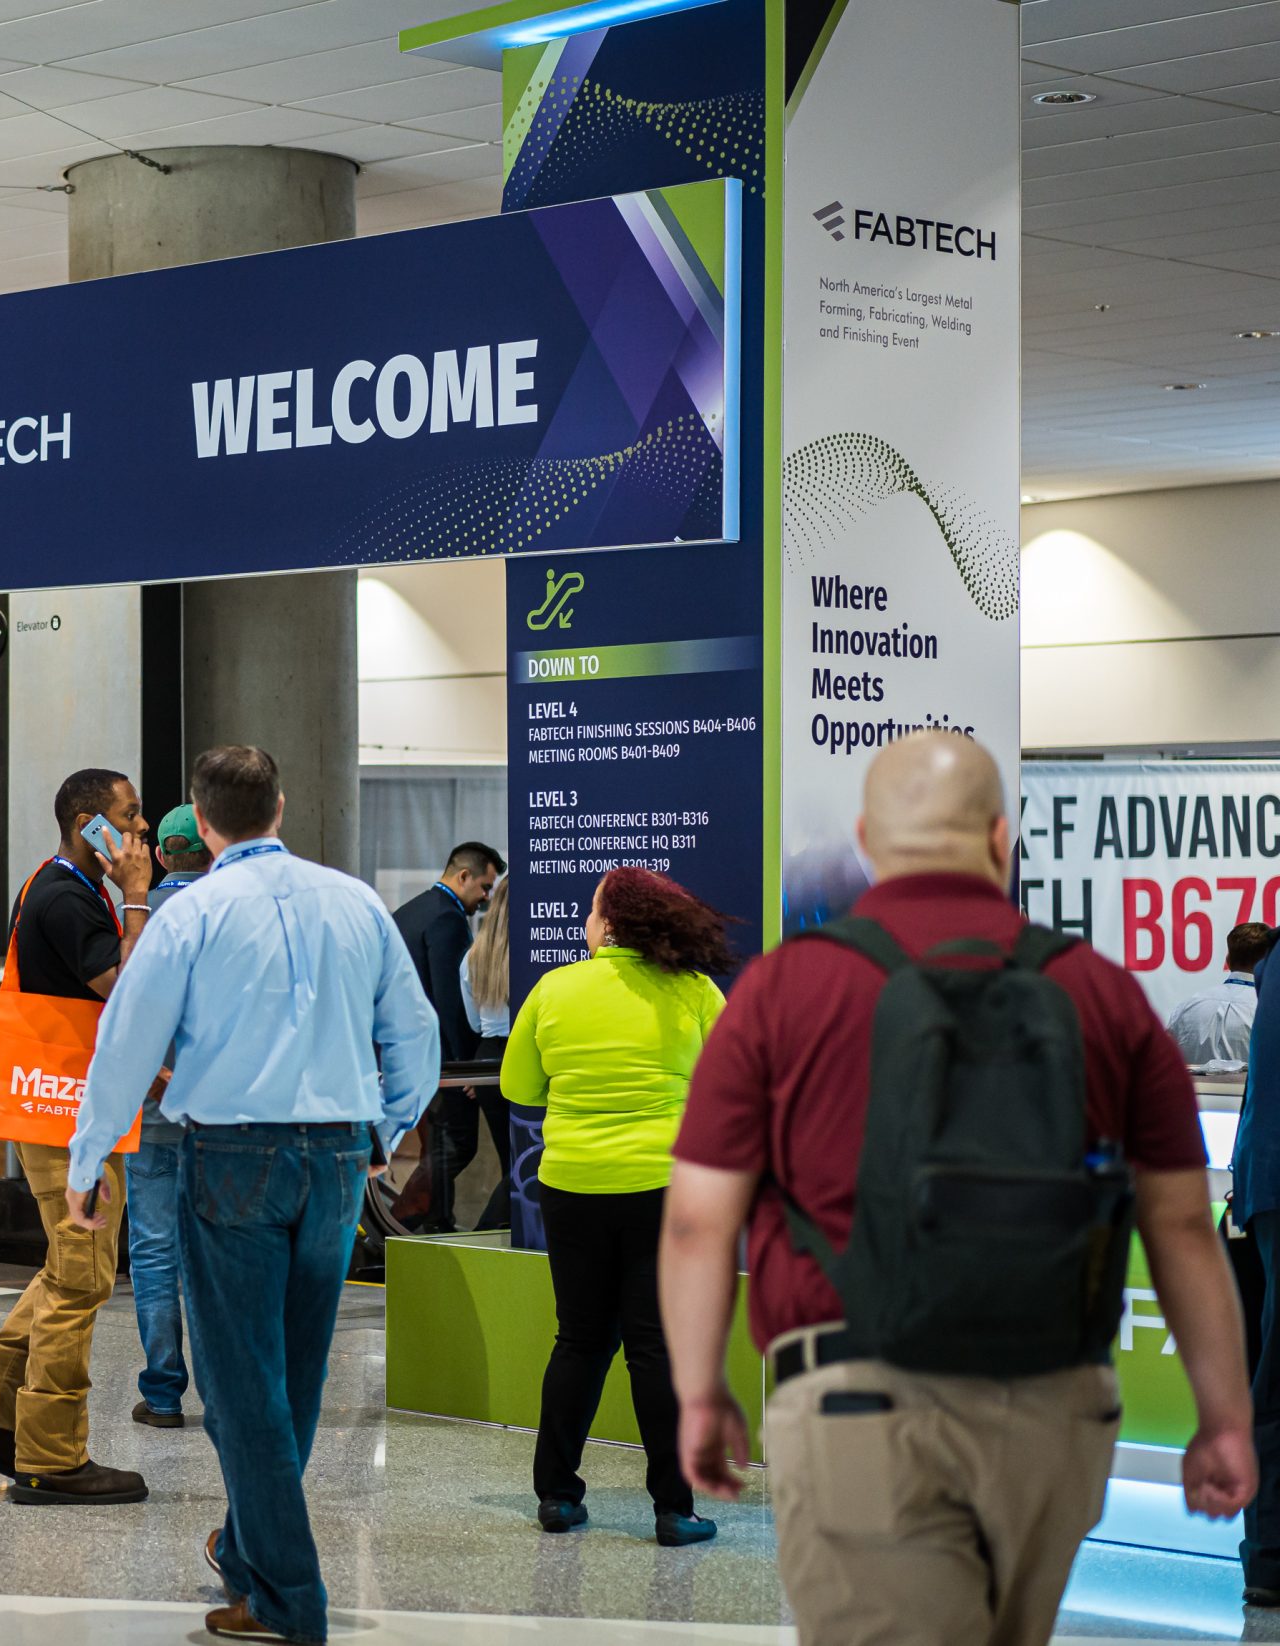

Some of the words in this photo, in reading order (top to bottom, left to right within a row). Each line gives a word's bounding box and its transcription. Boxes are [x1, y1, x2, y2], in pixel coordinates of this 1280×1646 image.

[855, 209, 996, 261] FABTECH
[820, 277, 850, 293] North
[906, 288, 942, 307] Largest
[944, 295, 973, 310] Metal
[820, 300, 866, 321] Forming,
[869, 306, 928, 329] Fabricating,
[931, 314, 972, 335] Welding
[820, 325, 839, 339] and
[843, 327, 888, 347] Finishing
[892, 333, 919, 348] Event
[191, 339, 538, 458] WELCOME
[811, 575, 888, 611] Where
[16, 620, 48, 632] Elevator
[812, 622, 938, 659] Innovation
[528, 657, 574, 678] DOWN
[579, 655, 600, 675] TO
[812, 668, 884, 702] Meets
[528, 702, 566, 719] LEVEL
[569, 701, 578, 717] 4
[529, 726, 573, 741] FABTECH
[577, 723, 632, 739] FINISHING
[635, 720, 689, 736] SESSIONS
[693, 717, 756, 733] B404-B406
[529, 748, 575, 764] MEETING
[578, 746, 618, 762] ROOMS
[621, 744, 680, 759] B401-B409
[529, 791, 567, 808] LEVEL
[570, 791, 578, 806] 3
[529, 815, 574, 830] FABTECH
[577, 813, 648, 829] CONFERENCE
[651, 811, 709, 827] B301-B316
[1094, 794, 1280, 859] ADVANC
[529, 838, 574, 852] FABTECH
[577, 835, 648, 851] CONFERENCE
[651, 835, 669, 852] HQ
[672, 835, 696, 849] B311
[529, 859, 576, 874] MEETING
[579, 859, 619, 873] ROOMS
[530, 902, 568, 918] LEVEL
[570, 902, 579, 918] 2
[530, 927, 564, 940] MEDIA
[566, 927, 587, 940] CEN
[530, 949, 577, 963] MEETING
[37, 1103, 80, 1117] FABTE
